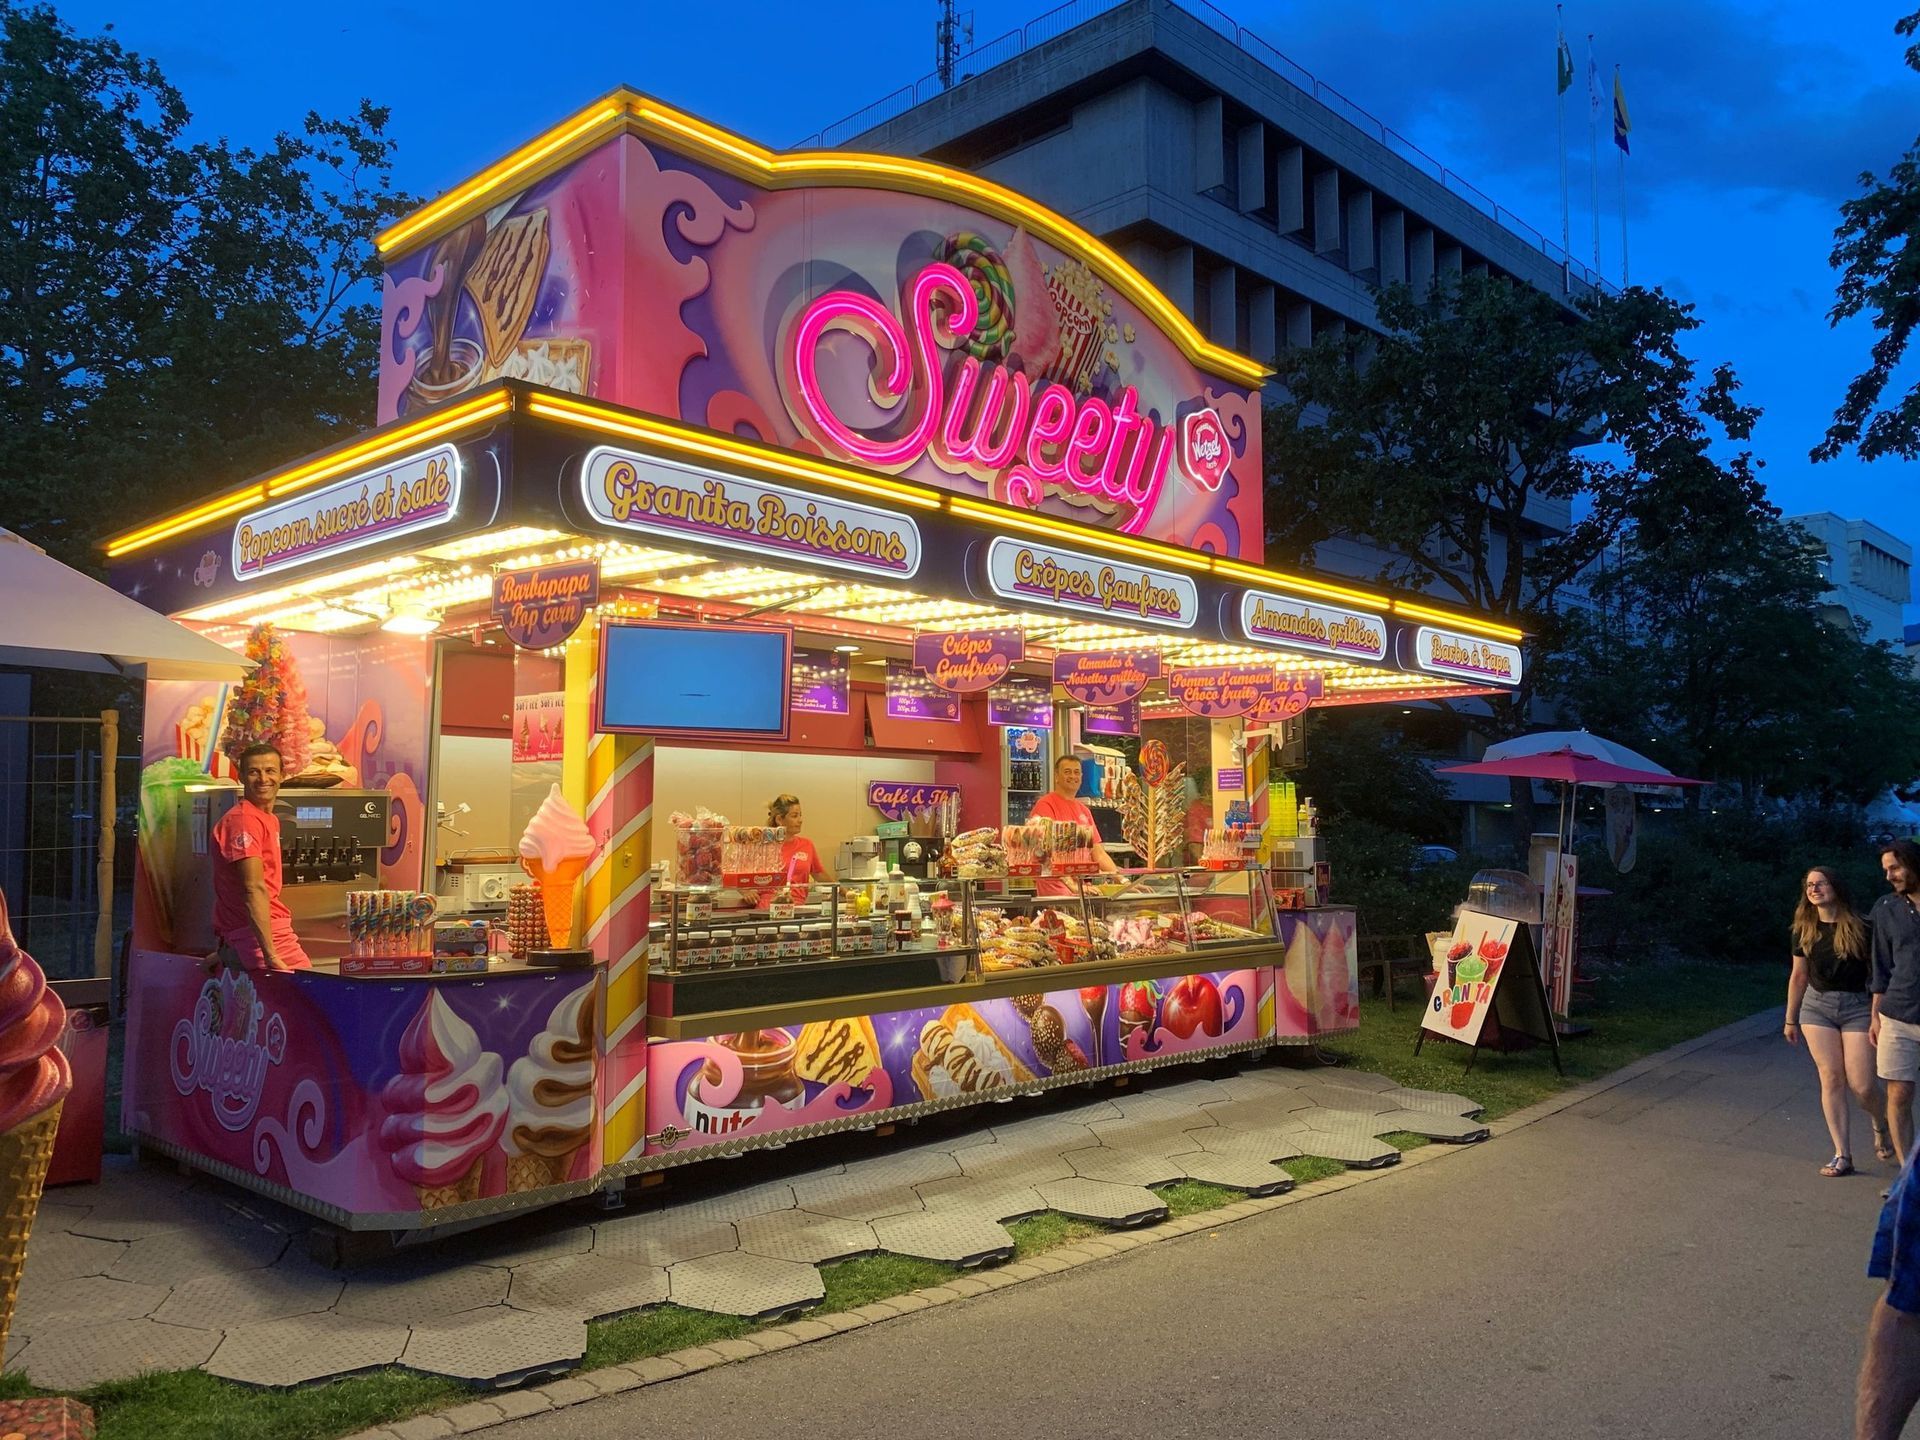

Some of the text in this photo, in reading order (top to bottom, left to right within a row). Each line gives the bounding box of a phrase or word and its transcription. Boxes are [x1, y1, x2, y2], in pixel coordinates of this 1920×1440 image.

[794, 261, 1175, 536] Sweety
[1191, 431, 1222, 462] Wetzel
[239, 457, 451, 571] Popcorn sucré et salé
[603, 460, 908, 563] Granita Boissons
[500, 571, 591, 606] Barbapapa
[1014, 549, 1182, 618] Crêpes Gaufres
[509, 602, 578, 636] Pop corn
[1251, 598, 1382, 650] Amandes grillées
[942, 633, 993, 661] Crêpes
[1430, 633, 1512, 678] Barbe à Papa
[935, 656, 1000, 685] Gaufres
[1077, 654, 1135, 671] Amandes &
[1065, 668, 1146, 688] Noisettes grillées
[1171, 671, 1272, 689] Pomme d'amour
[1292, 676, 1308, 693] &
[1184, 684, 1259, 705] Choco fruits
[1273, 695, 1301, 714] Ice
[872, 786, 950, 808] Café & Th
[1433, 982, 1491, 1012] GRANITA
[171, 996, 270, 1131] Sweety
[695, 1110, 757, 1135] nut
